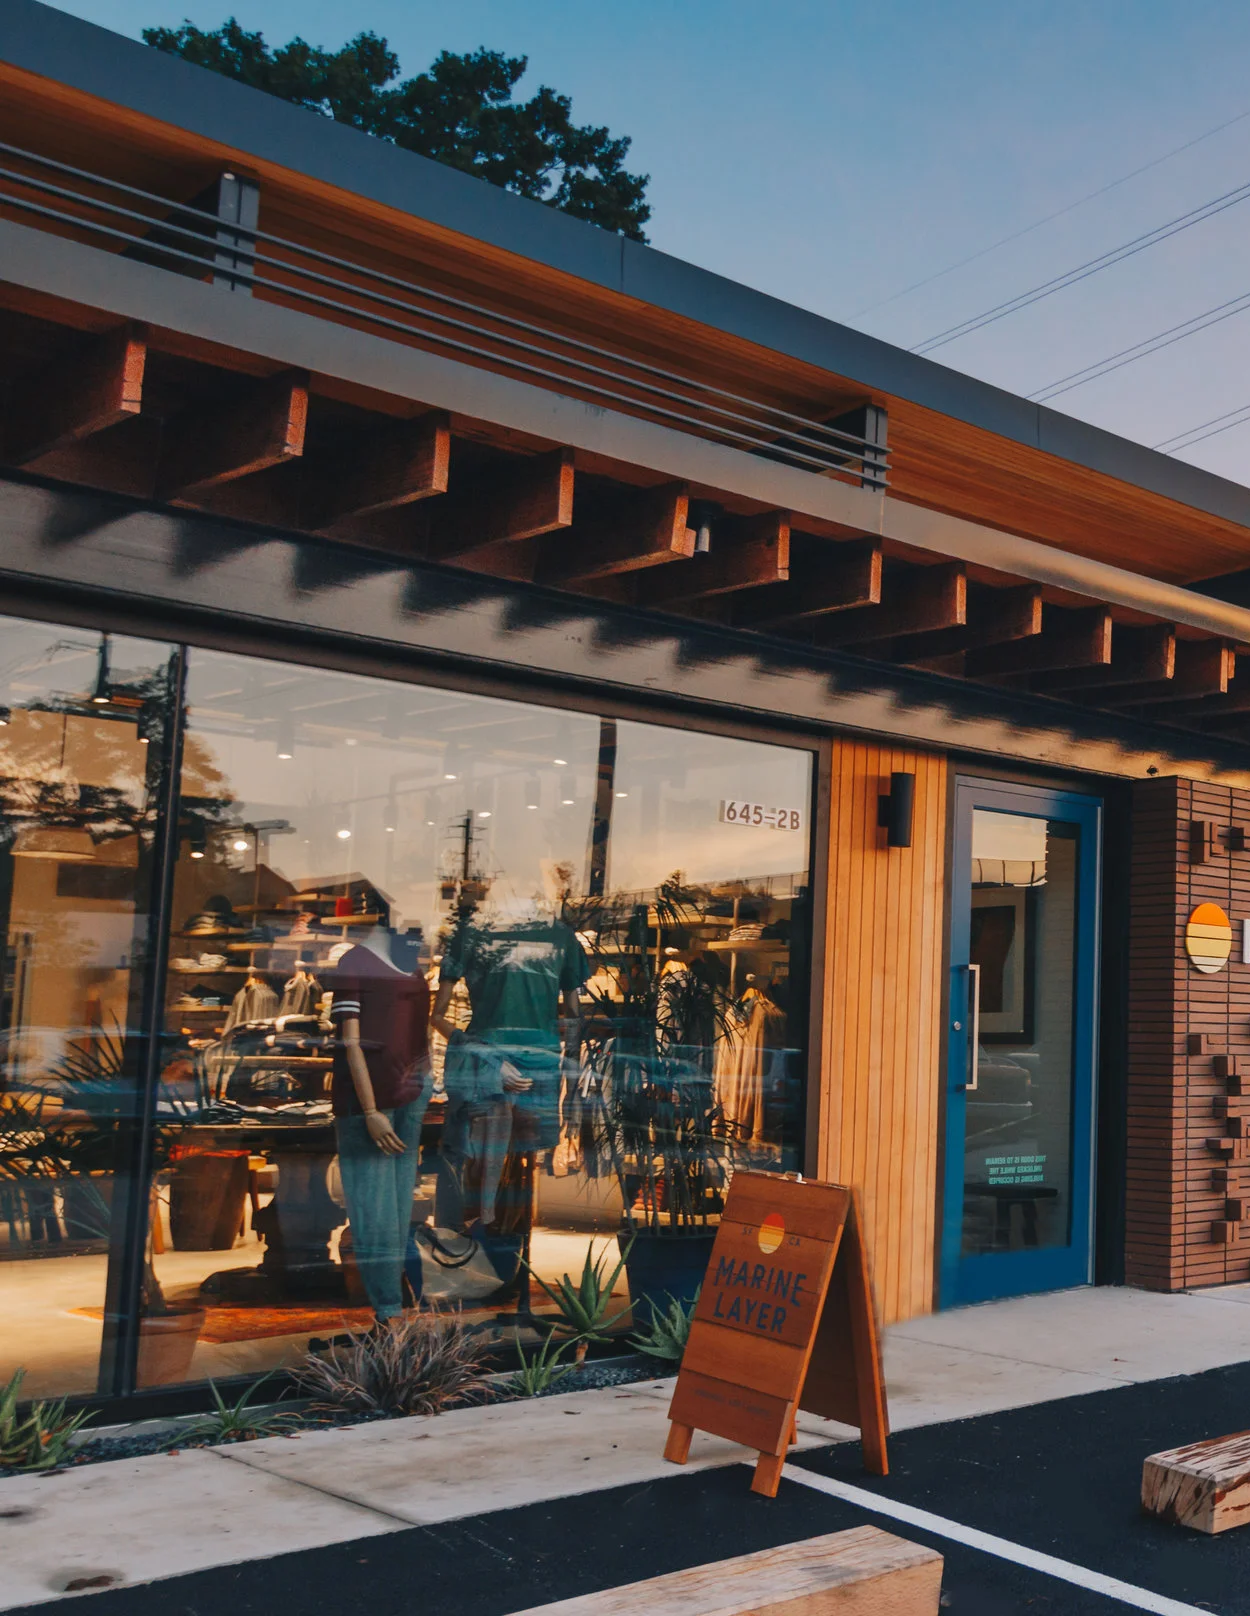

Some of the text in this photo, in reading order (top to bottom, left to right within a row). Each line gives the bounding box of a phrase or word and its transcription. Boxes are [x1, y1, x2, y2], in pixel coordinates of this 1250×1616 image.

[726, 801, 800, 831] 645-2B
[713, 1256, 807, 1307] MARINE
[713, 1291, 786, 1334] LAYER
